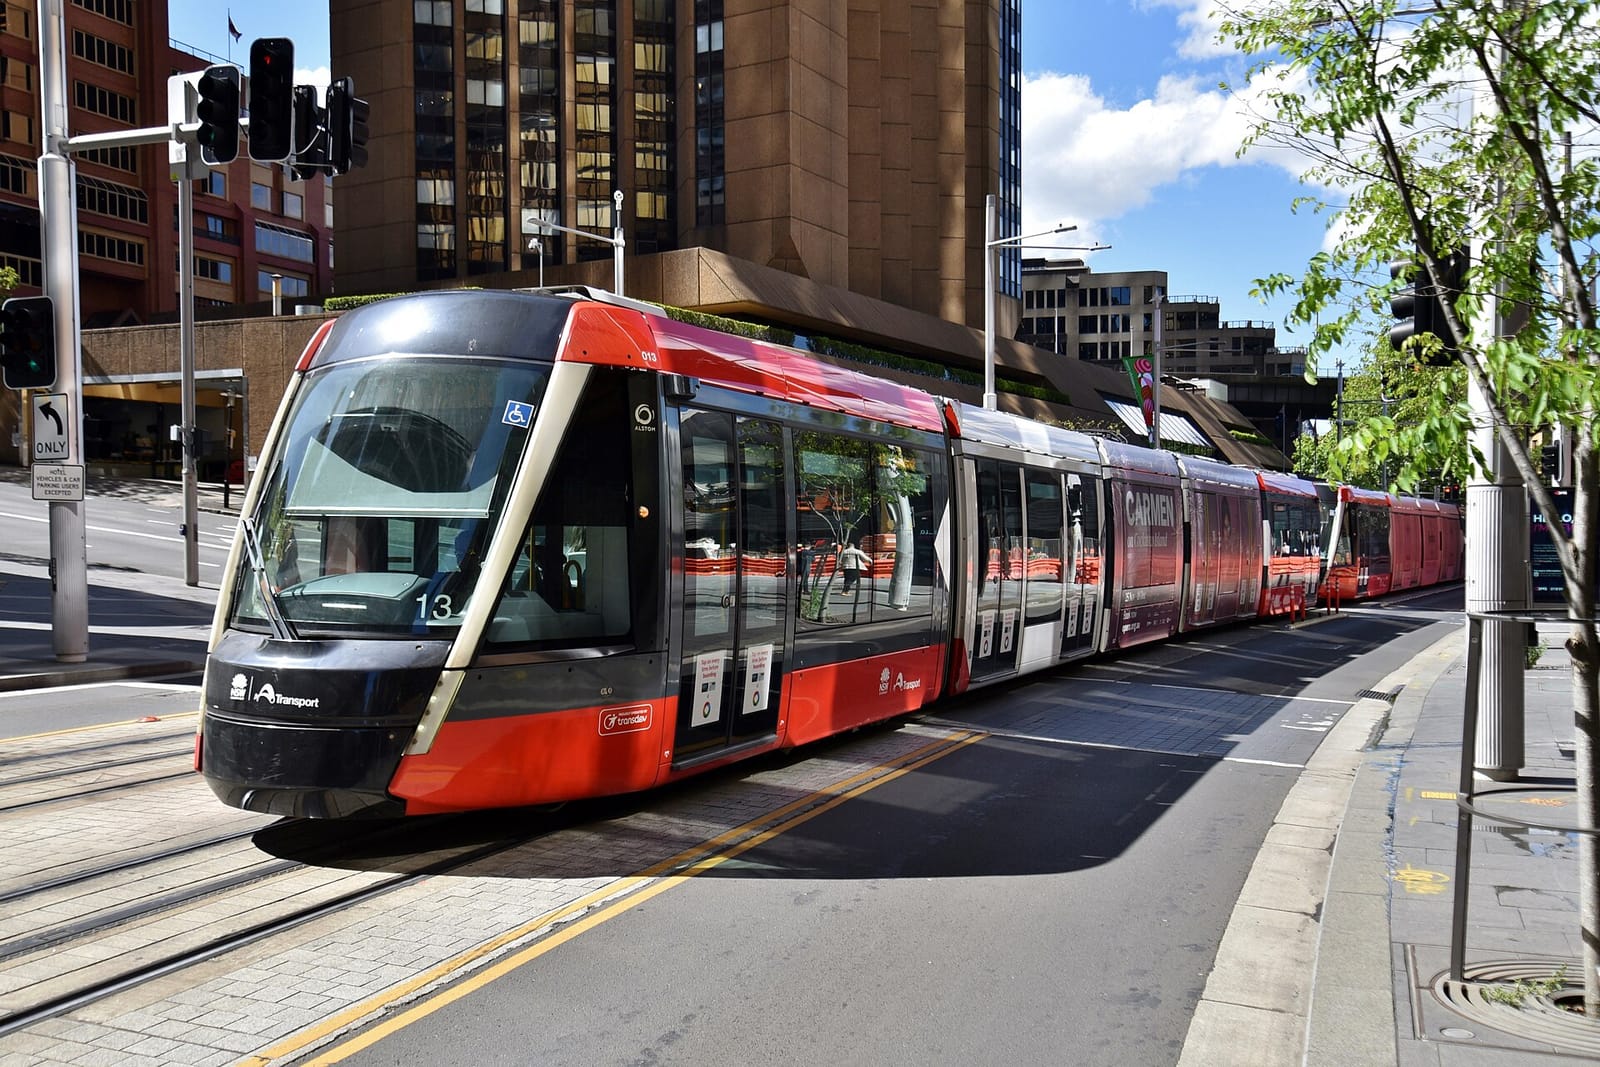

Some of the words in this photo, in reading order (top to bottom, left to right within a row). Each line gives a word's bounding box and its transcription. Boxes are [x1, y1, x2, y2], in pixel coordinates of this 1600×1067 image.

[641, 351, 656, 362] 013
[36, 442, 66, 453] ONLY
[1125, 490, 1174, 527] CARMEN
[416, 593, 452, 620] 13
[903, 678, 920, 690] Transport
[275, 693, 319, 708] Transport
[617, 714, 648, 726] transdev
